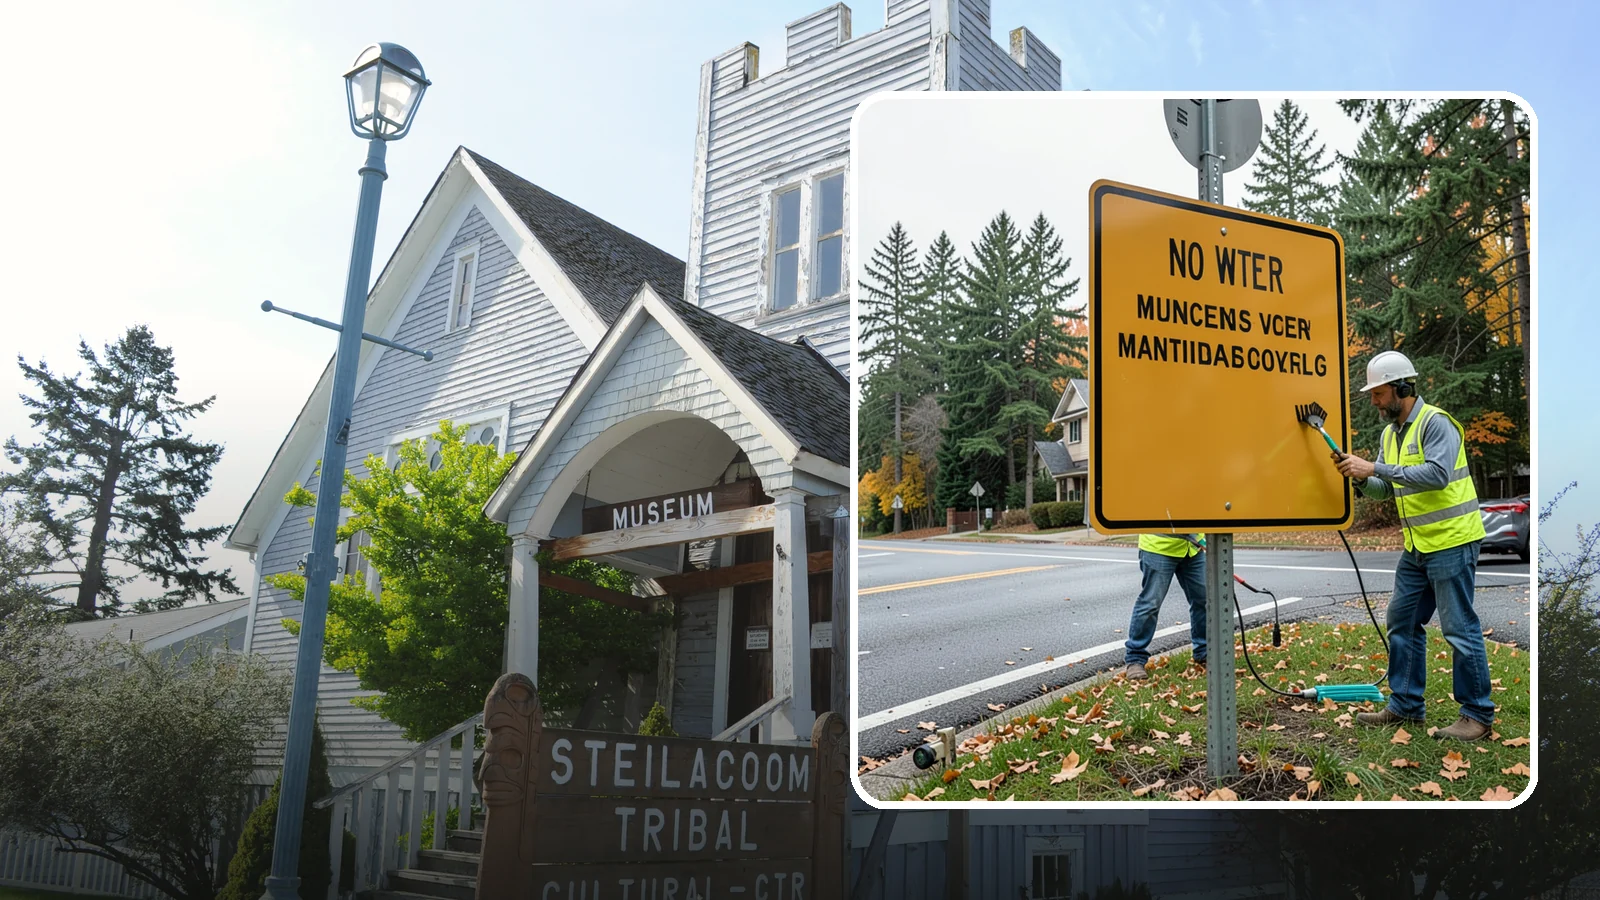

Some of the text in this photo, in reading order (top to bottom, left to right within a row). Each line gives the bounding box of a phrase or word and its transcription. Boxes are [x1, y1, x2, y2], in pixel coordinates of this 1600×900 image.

[1169, 237, 1284, 294] NO WTER
[1137, 294, 1311, 341] MUNCENS VCER
[612, 491, 714, 531] MUSEUM
[551, 738, 809, 792] STEILACOOM
[615, 806, 758, 851] TRIBAL
